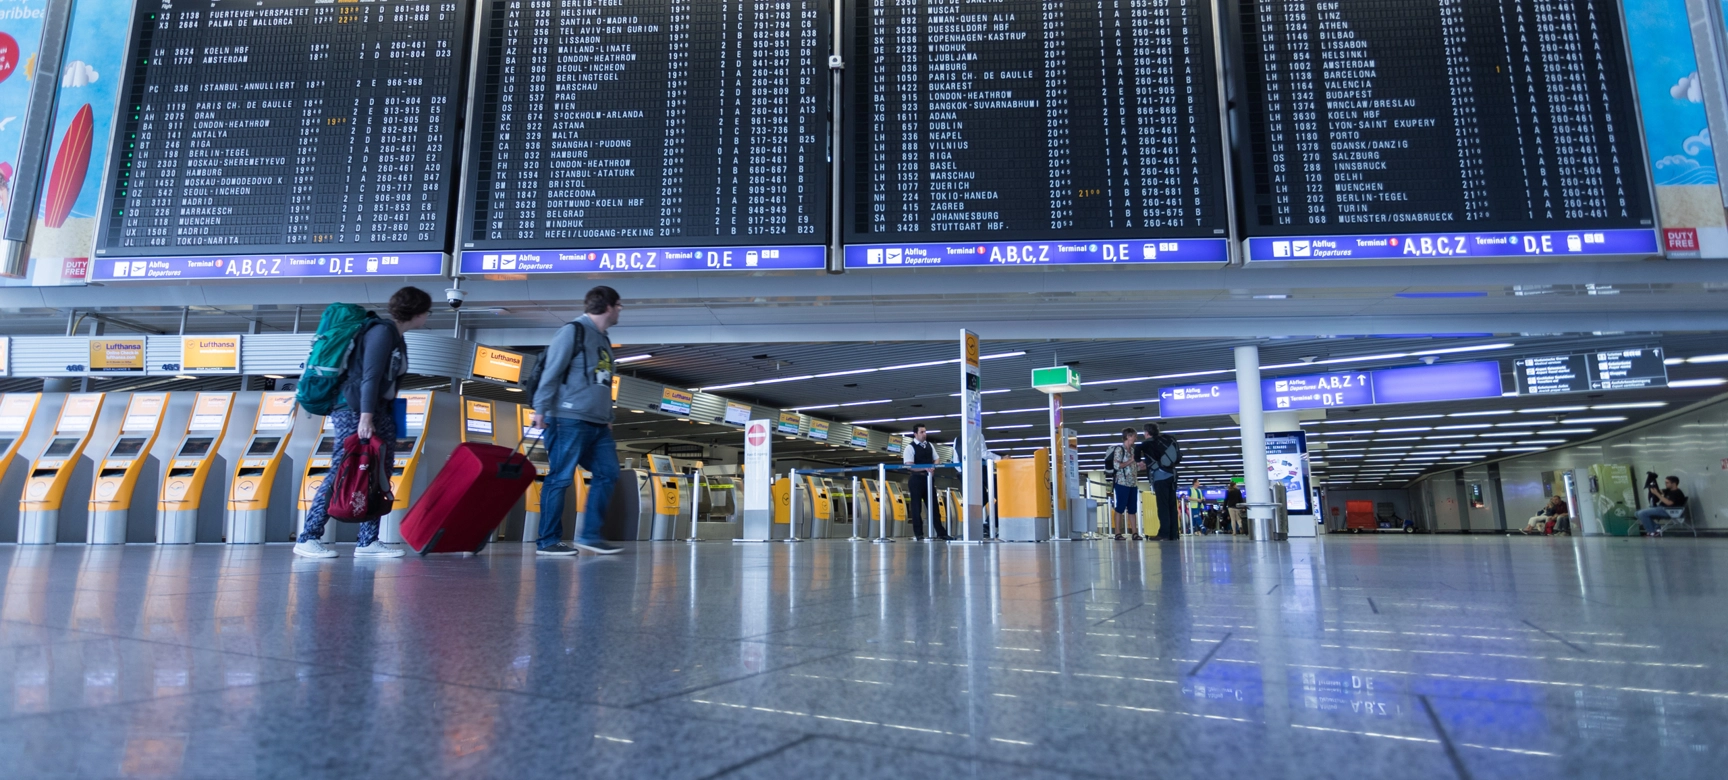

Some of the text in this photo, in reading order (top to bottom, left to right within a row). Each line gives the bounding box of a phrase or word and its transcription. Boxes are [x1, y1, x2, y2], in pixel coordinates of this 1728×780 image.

[210, 8, 309, 18] FUERTEVEN-VERSPAETET
[928, 6, 959, 14] MUSCAT
[253, 18, 293, 26] MALLORCA
[928, 15, 987, 23] AMMAN-QUEEN
[580, 26, 622, 34] AVIV-BEN
[928, 25, 987, 33] DUESSELDORF
[1319, 22, 1347, 30] ATHEN
[559, 36, 600, 44] LISSABON
[928, 33, 1026, 42] KOPENHAGEN-KASTRUP
[558, 45, 631, 53] MAILAND-LINATE
[1321, 41, 1367, 49] LISSABON
[558, 54, 636, 62] LONDON-HEATHROW
[1322, 51, 1367, 59] HELSINKI
[557, 64, 625, 72] DEOUL-INCHEON
[929, 63, 967, 71] HAMBURG
[1323, 60, 1375, 68] AMSTERDAM
[1324, 70, 1376, 79] BARCELONA
[200, 82, 295, 91] ISTANBUL-ANNULLIERT
[1325, 80, 1371, 88] VALENCIA
[929, 92, 1012, 100] LONDON-HEATHROW
[1326, 91, 1372, 99] BUDAPEST
[929, 100, 1039, 110] BANGKOK-SUVARNABHUMI
[194, 121, 270, 129] LONDON-HEATHROW
[930, 122, 963, 130] DUBLIN
[1329, 119, 1435, 129] LYON-SAINT EXUPERY
[930, 132, 962, 140] NEAPEL
[552, 140, 631, 148] SHANGHAI-PUDONG
[1331, 140, 1408, 149] GDANSK/DANZIG
[189, 149, 249, 157] BERLIN-TEGEL
[1332, 152, 1379, 160] SALZBURG
[188, 158, 286, 166] MOSKAU-SHEREMETYEVO
[550, 160, 630, 168] LONDON-HEATHROW
[1334, 162, 1387, 170] INNSBRUCK
[550, 169, 635, 178] ISTANBUL-ATATURK
[185, 178, 272, 186] MOSKAU-DOMODEDOVO
[549, 180, 585, 188] BRISTOL
[930, 182, 969, 190] ZUERICH
[1335, 183, 1383, 191] MUENCHEN
[183, 188, 250, 196] SEOUL-INCHEON
[931, 192, 998, 200] TOKIO-HANEDA
[1336, 193, 1408, 202] BERLIN-TEGEL
[547, 199, 623, 207] DORTMUND-KOELN
[547, 210, 584, 218] BELGRAD
[931, 212, 999, 221] JOHANNESBURG
[1338, 213, 1453, 223] MUENSTER/OSNABRUECK
[546, 220, 584, 228] WINDHUK
[931, 223, 981, 231] STUTTGART
[545, 229, 654, 238] HEFEI/LUOGANG-PEKING
[177, 237, 238, 245] TOKIO-NARITA
[1312, 240, 1336, 248] Abflug
[1524, 235, 1553, 254] D,E
[1403, 236, 1466, 256] A,B,C,Z
[905, 248, 927, 256] Abflug
[990, 245, 1049, 263] A,B,C,Z
[1103, 244, 1129, 262] D,E
[1314, 249, 1352, 257] Departures
[519, 254, 540, 262] Abflug
[599, 252, 656, 270] A,B,C,Z
[707, 251, 732, 268] D,E
[905, 256, 941, 264] Departures
[226, 258, 281, 276] A,B,C,Z
[330, 257, 354, 274] D,E
[518, 262, 553, 270] Departures
[148, 269, 181, 277] Departures
[491, 352, 520, 364] Lufthansa
[1318, 375, 1352, 391] A,B,Z
[1211, 386, 1220, 397] C
[1323, 392, 1343, 405] D,E
